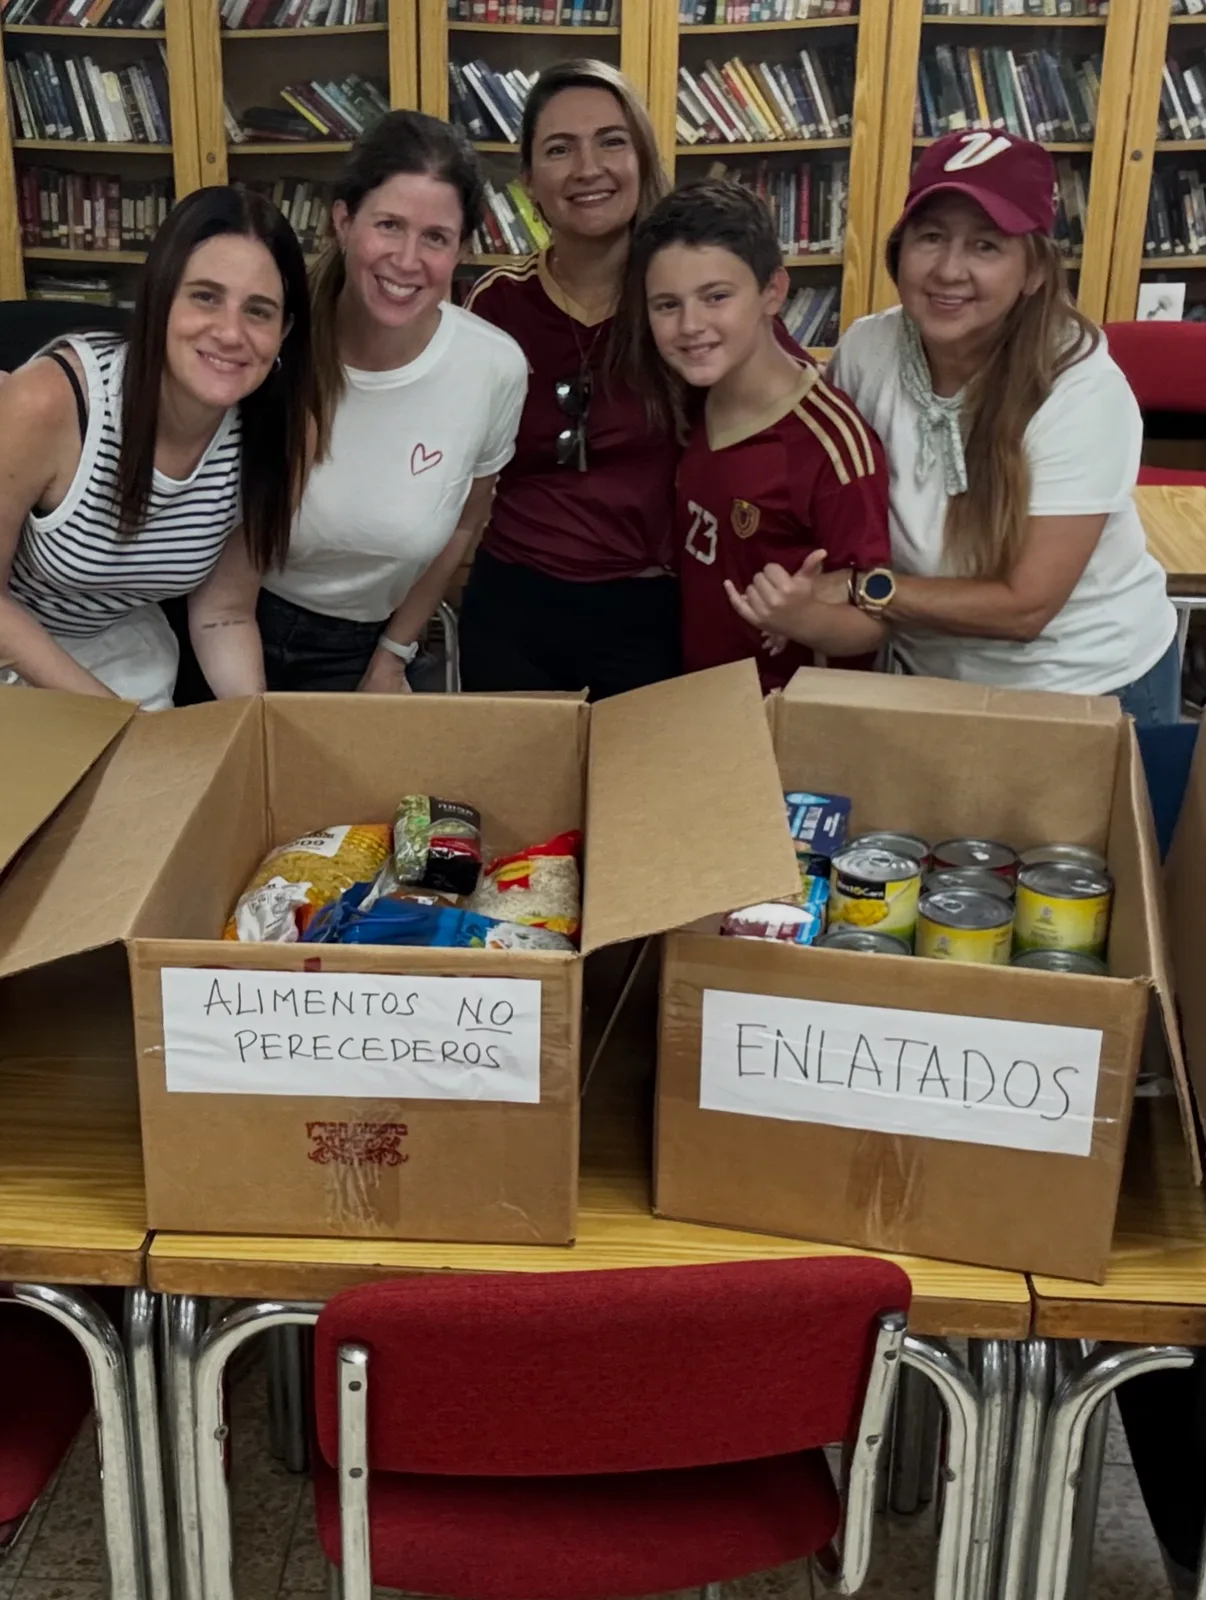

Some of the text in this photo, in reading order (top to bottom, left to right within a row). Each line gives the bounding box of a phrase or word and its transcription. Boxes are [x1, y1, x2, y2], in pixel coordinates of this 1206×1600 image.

[685, 500, 718, 565] 23
[203, 978, 514, 1027] ALIMENTOS NO
[234, 1030, 501, 1069] PERECEDEROS
[737, 1023, 1080, 1121] ENLATADOS
